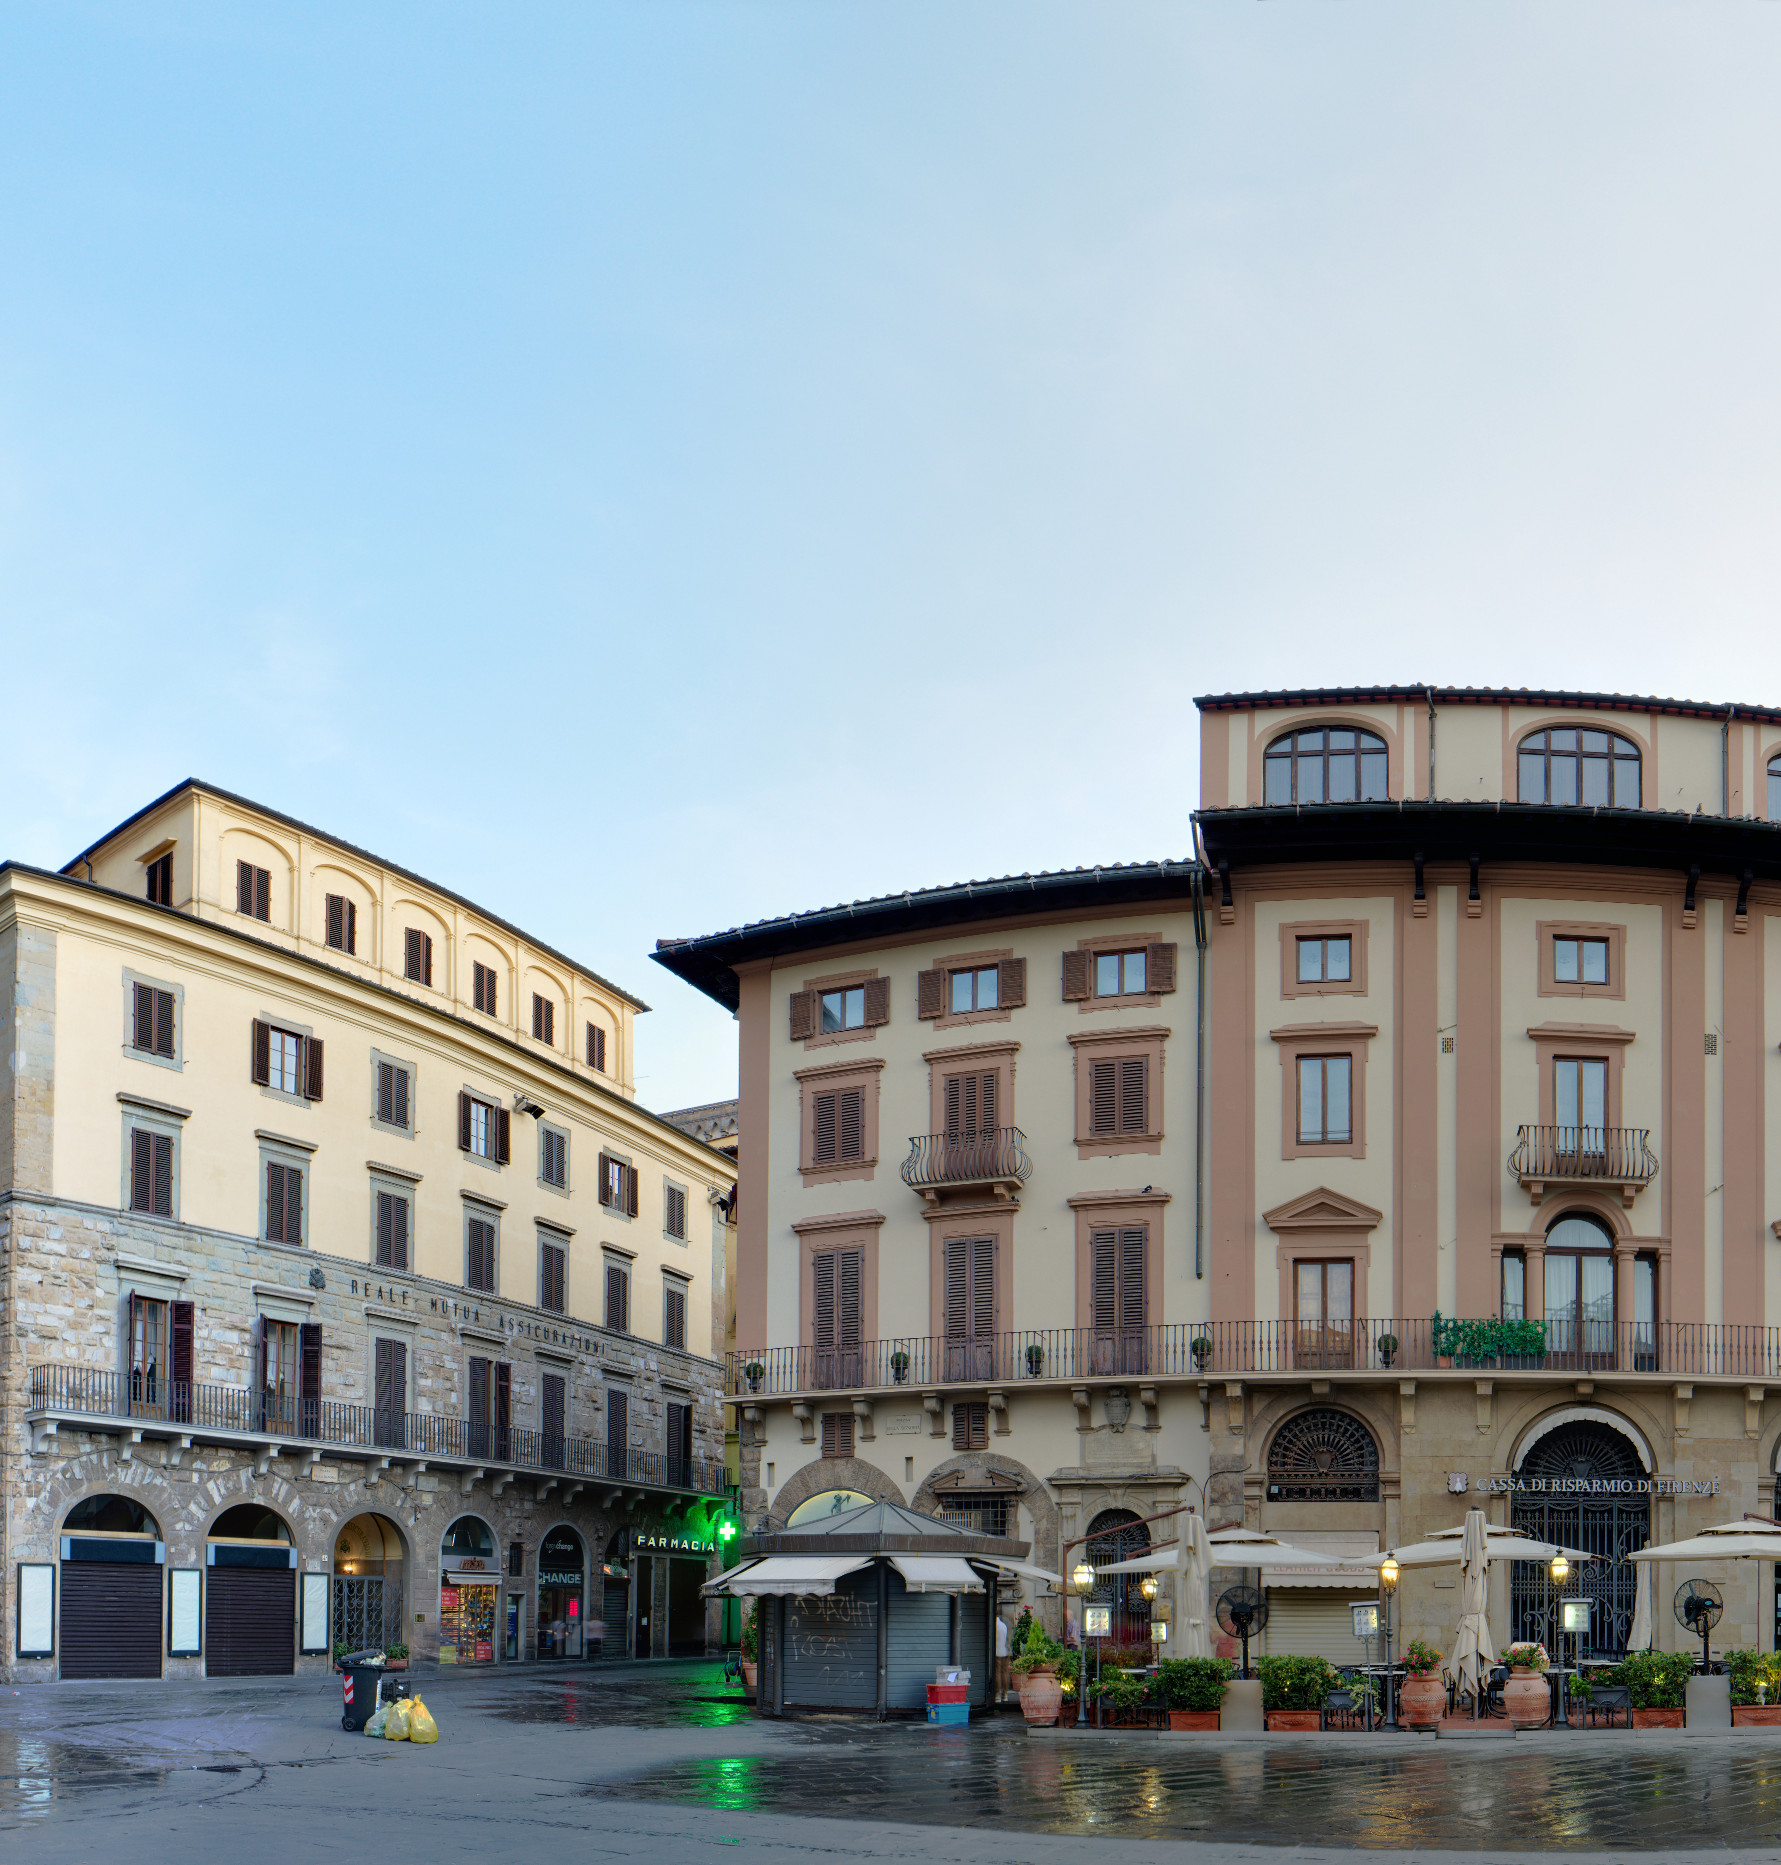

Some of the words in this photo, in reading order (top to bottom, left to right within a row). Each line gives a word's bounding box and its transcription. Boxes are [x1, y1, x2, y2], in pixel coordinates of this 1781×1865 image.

[351, 1279, 409, 1305] REALE
[430, 1297, 480, 1323] MUTUA
[499, 1314, 606, 1355] ASSICURAZIONI
[1476, 1478, 1526, 1491] CASSA
[1531, 1479, 1546, 1491] DI
[1551, 1479, 1633, 1493] RISPARMIO
[1637, 1480, 1653, 1493] DI
[1656, 1480, 1721, 1494] FIRENZE
[637, 1535, 715, 1552] FARMACIA
[538, 1571, 582, 1584] CHANGE
